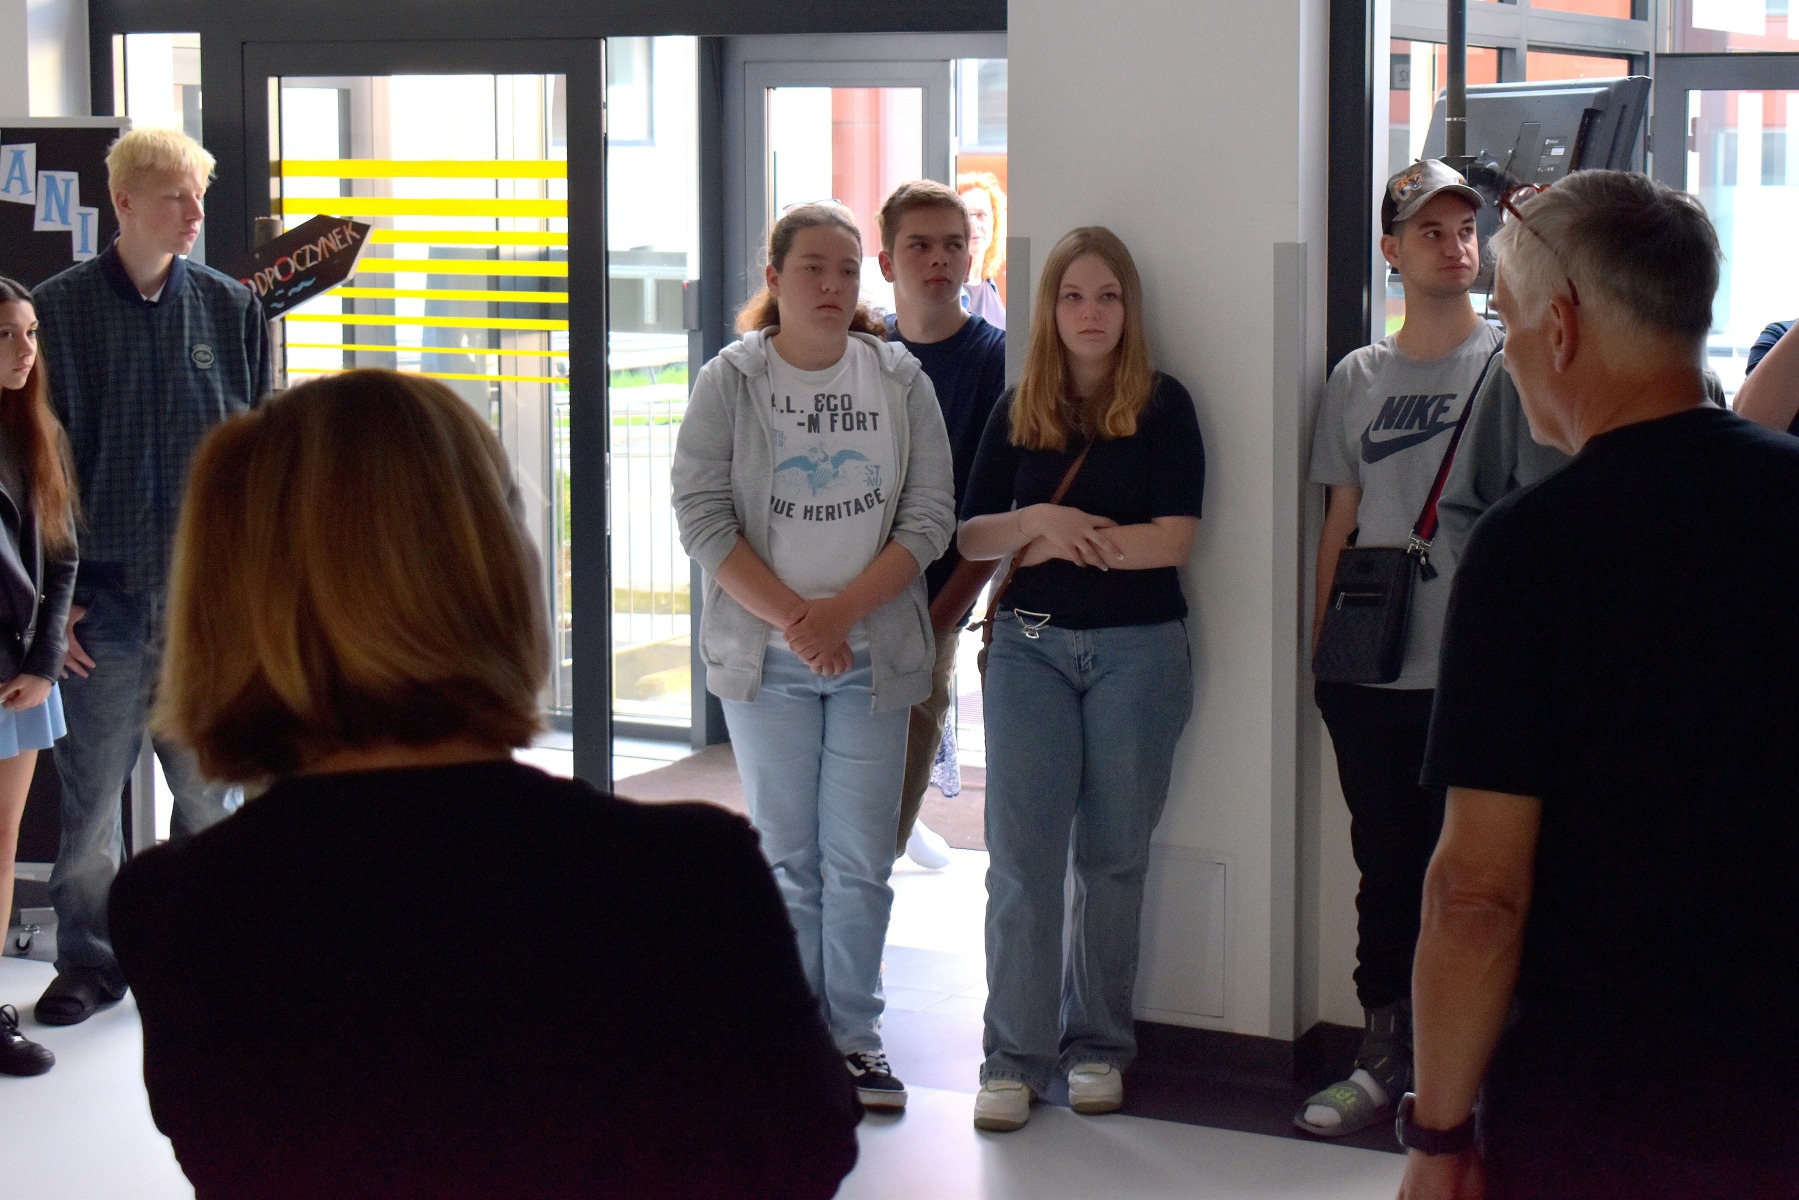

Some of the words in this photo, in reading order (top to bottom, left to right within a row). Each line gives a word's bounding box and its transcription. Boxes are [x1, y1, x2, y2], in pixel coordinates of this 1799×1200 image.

[829, 410, 879, 432] FORT
[1371, 393, 1458, 432] NIKE
[770, 495, 796, 518] UE
[803, 487, 886, 521] HERITAGE
